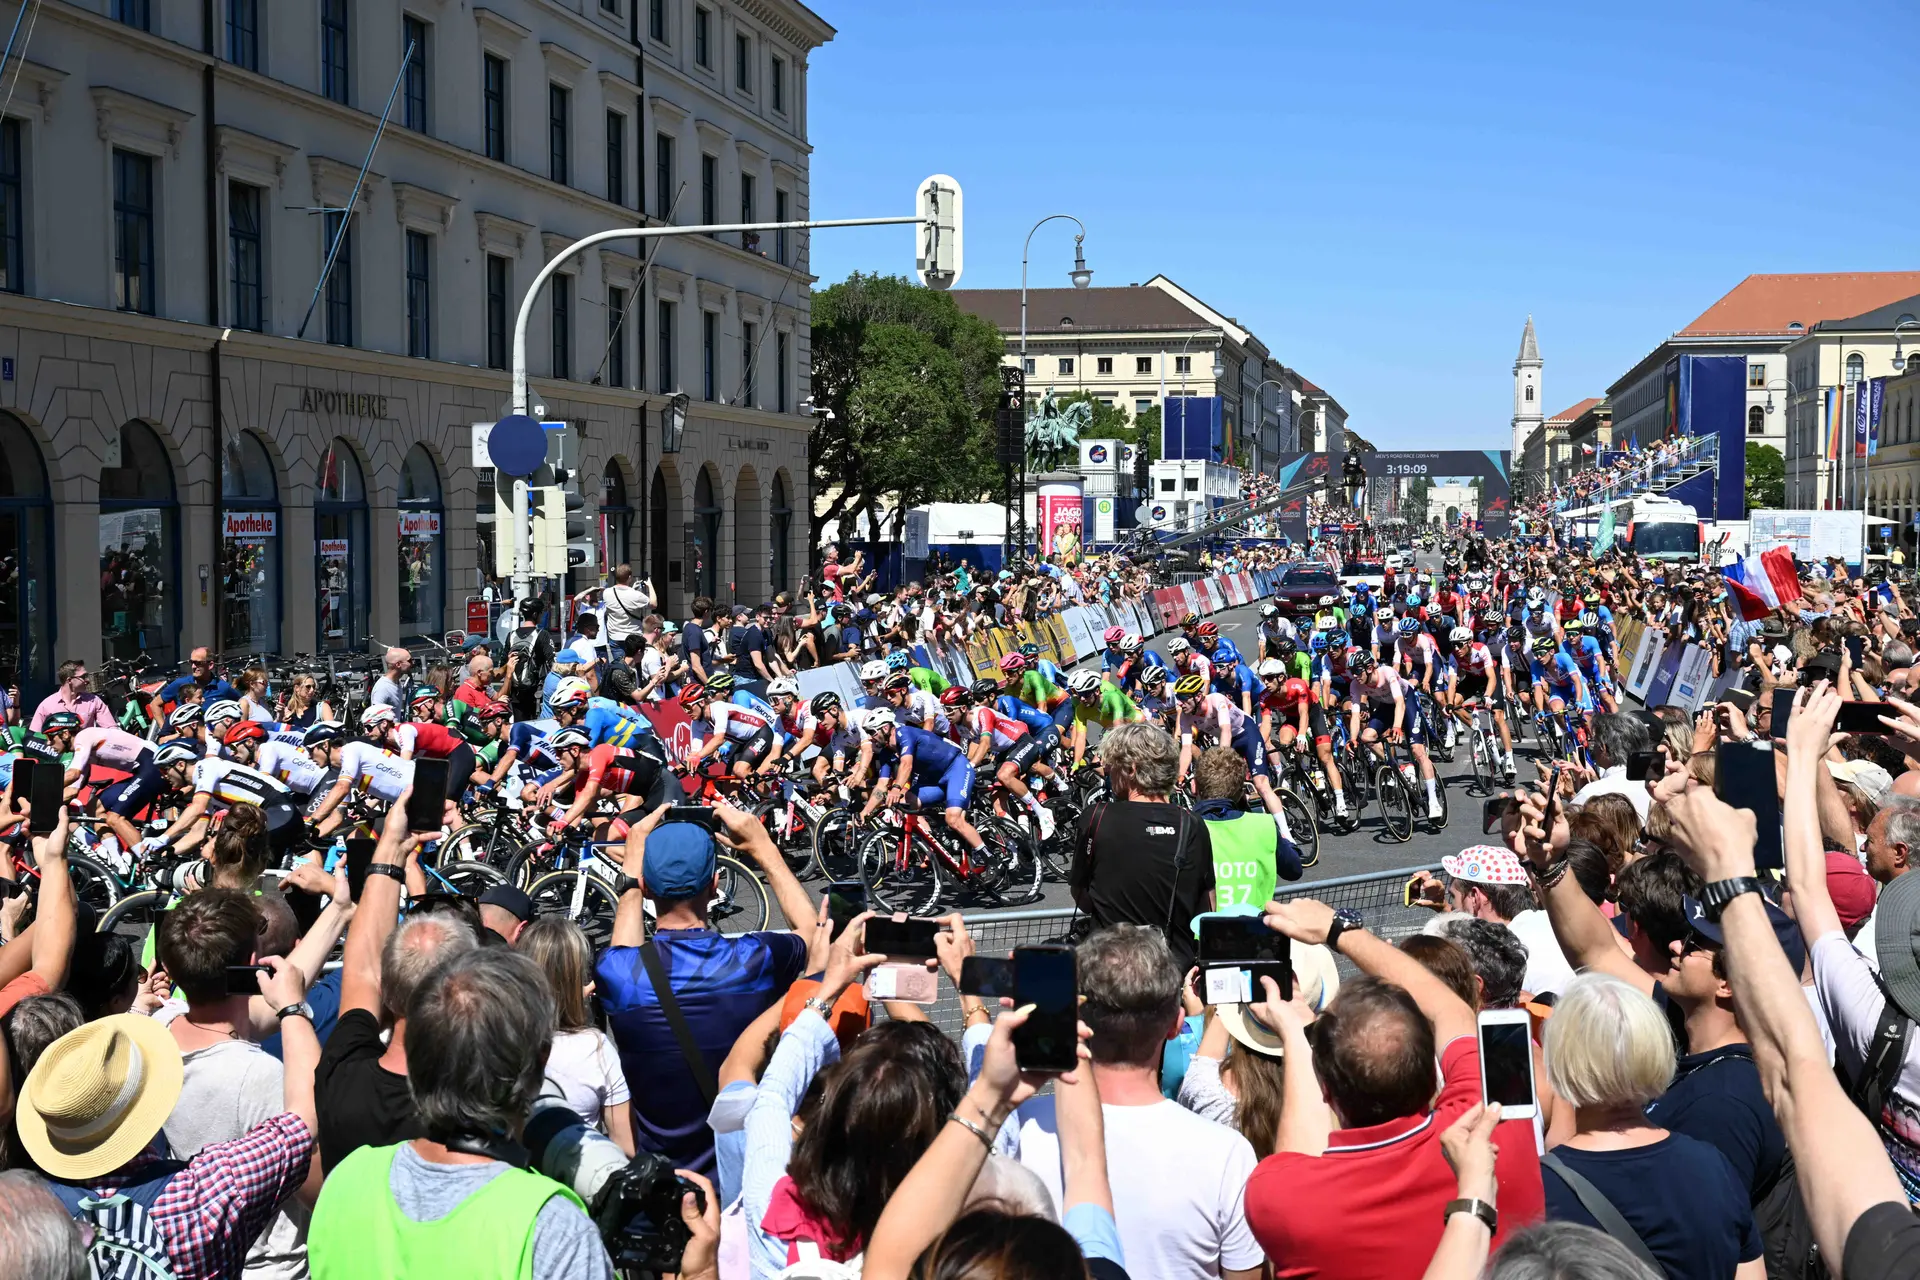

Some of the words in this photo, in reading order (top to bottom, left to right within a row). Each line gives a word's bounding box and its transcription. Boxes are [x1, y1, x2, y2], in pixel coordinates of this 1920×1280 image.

[302, 388, 388, 417] APOTHEKE
[1386, 464, 1428, 474] 3:19:09
[1054, 506, 1082, 517] JAGD
[226, 513, 273, 536] Apotheke
[404, 514, 438, 534] Apotheke
[1053, 516, 1082, 524] SAISON
[321, 540, 347, 554] Apotheke
[739, 713, 759, 726] LATVIA
[998, 721, 1019, 734] PORTUGAL
[273, 734, 304, 747] FRANC
[1014, 742, 1035, 762] PORTUGAL
[291, 757, 316, 772] Cofidis
[374, 762, 403, 780] Cofidis
[1155, 826, 1176, 835] EMG
[1218, 884, 1253, 907] 37
[1883, 1031, 1901, 1039] deuter
